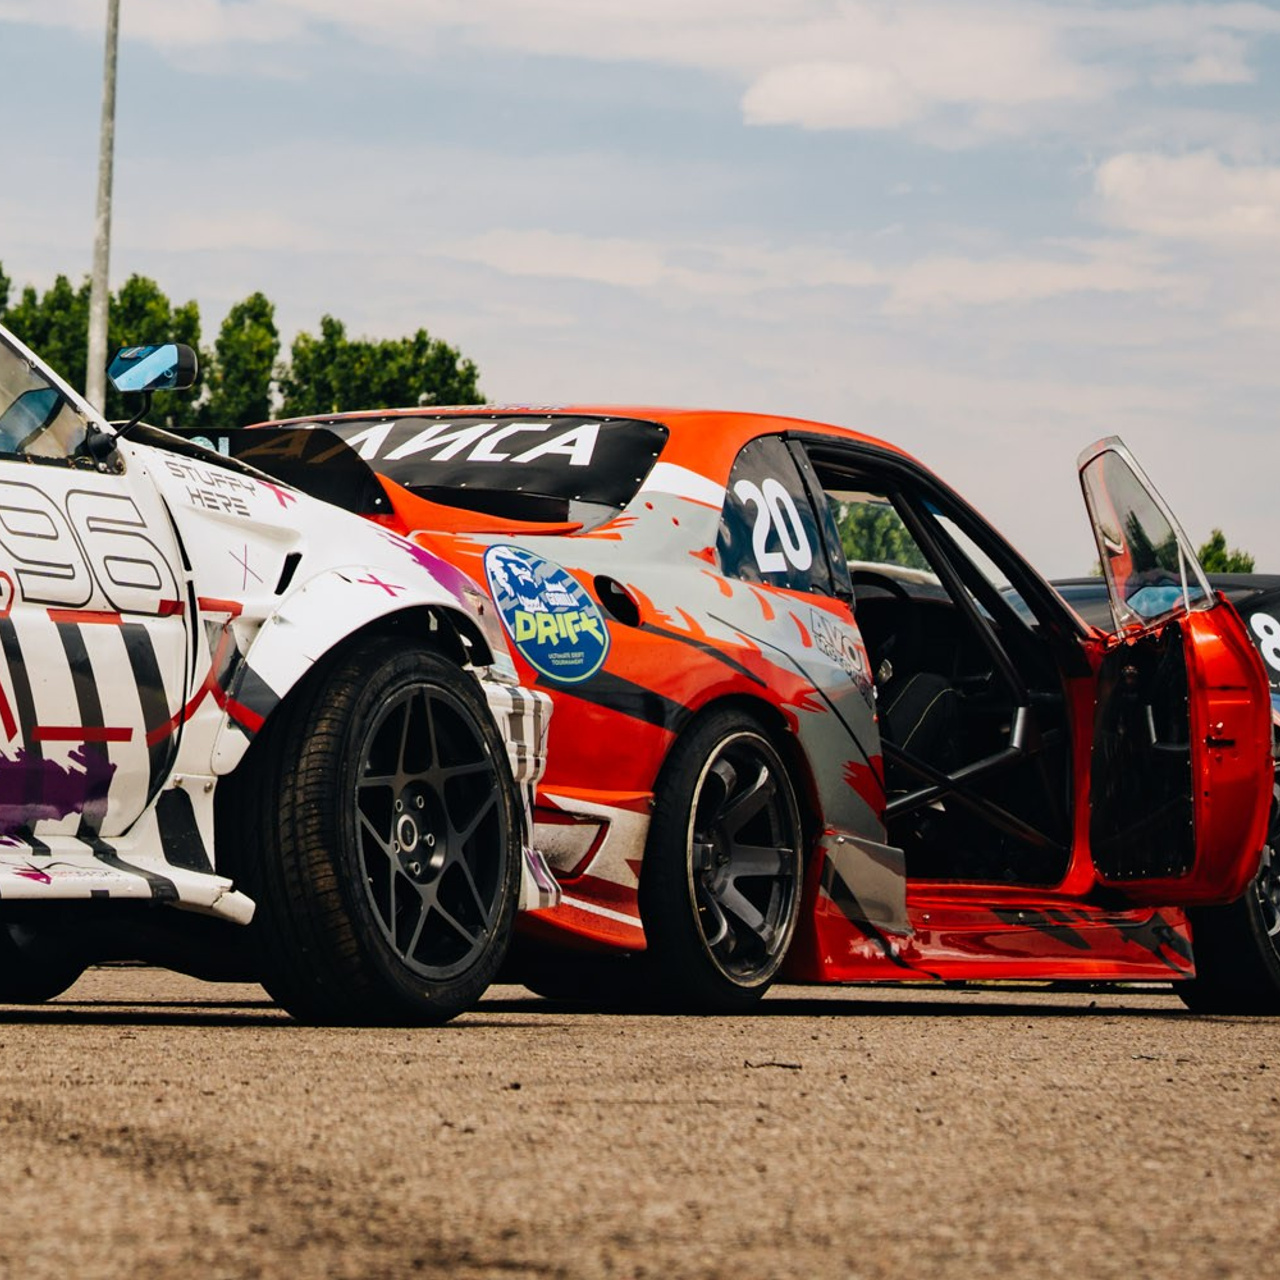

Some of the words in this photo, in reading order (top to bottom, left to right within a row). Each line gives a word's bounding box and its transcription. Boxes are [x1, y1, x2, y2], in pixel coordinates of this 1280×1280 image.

[186, 486, 251, 517] HERE
[734, 478, 812, 573] 20
[515, 610, 604, 646] DRIFT
[1250, 612, 1280, 672] 8
